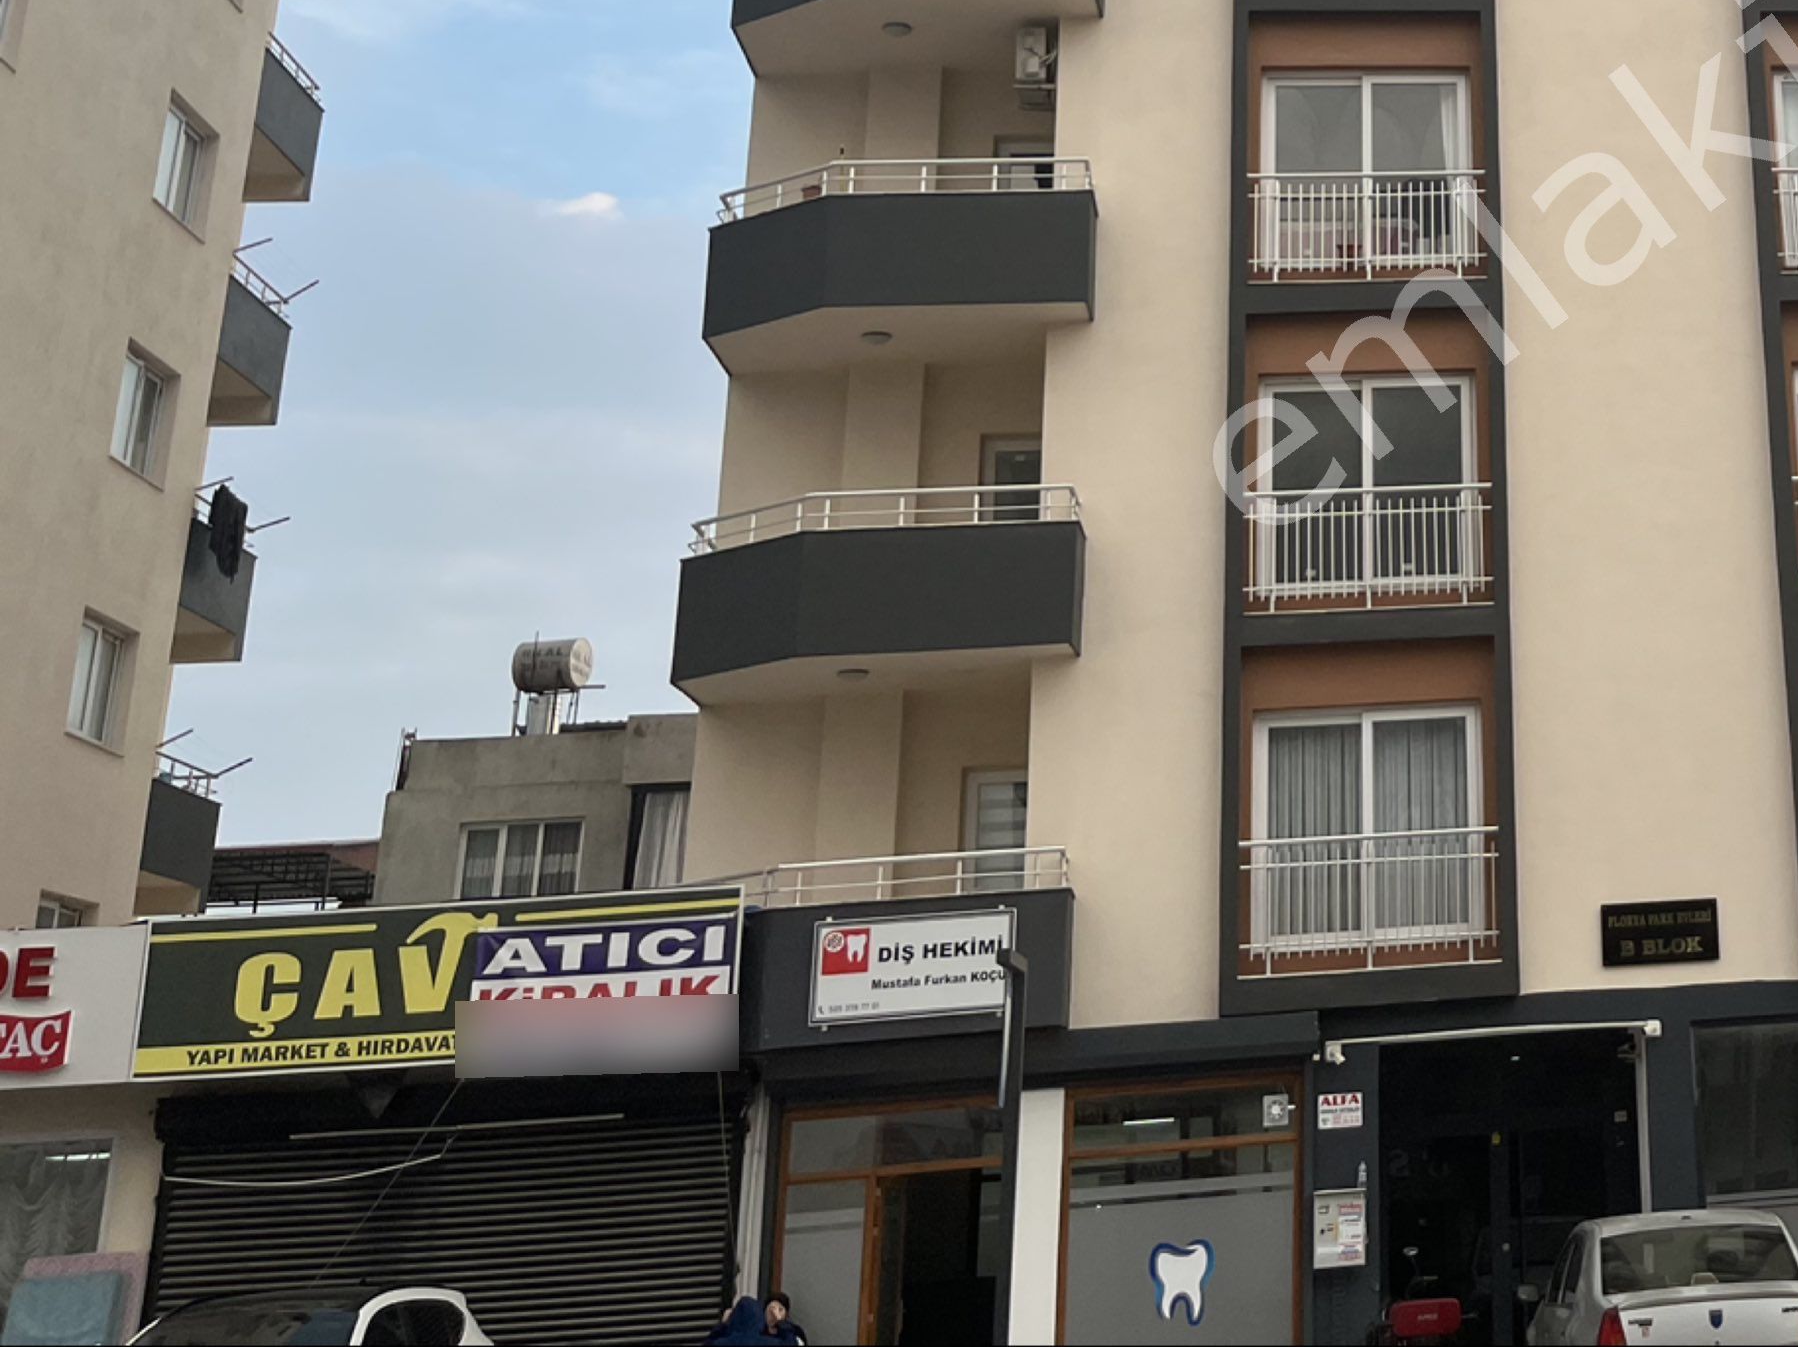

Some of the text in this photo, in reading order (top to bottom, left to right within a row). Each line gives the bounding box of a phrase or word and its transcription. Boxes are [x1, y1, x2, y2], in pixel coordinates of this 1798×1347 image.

[482, 925, 726, 975] ATICI
[878, 942, 914, 964] DİŞ
[1620, 936, 1704, 956] B BLOK
[0, 947, 56, 998] E
[871, 976, 921, 990] Mustafa
[924, 973, 967, 987] Furkan
[0, 1019, 62, 1064] AÇ
[187, 1048, 235, 1066] YAPI
[241, 1042, 330, 1064] MARKET
[334, 1041, 350, 1057] &
[1321, 1094, 1360, 1107] ALFA
